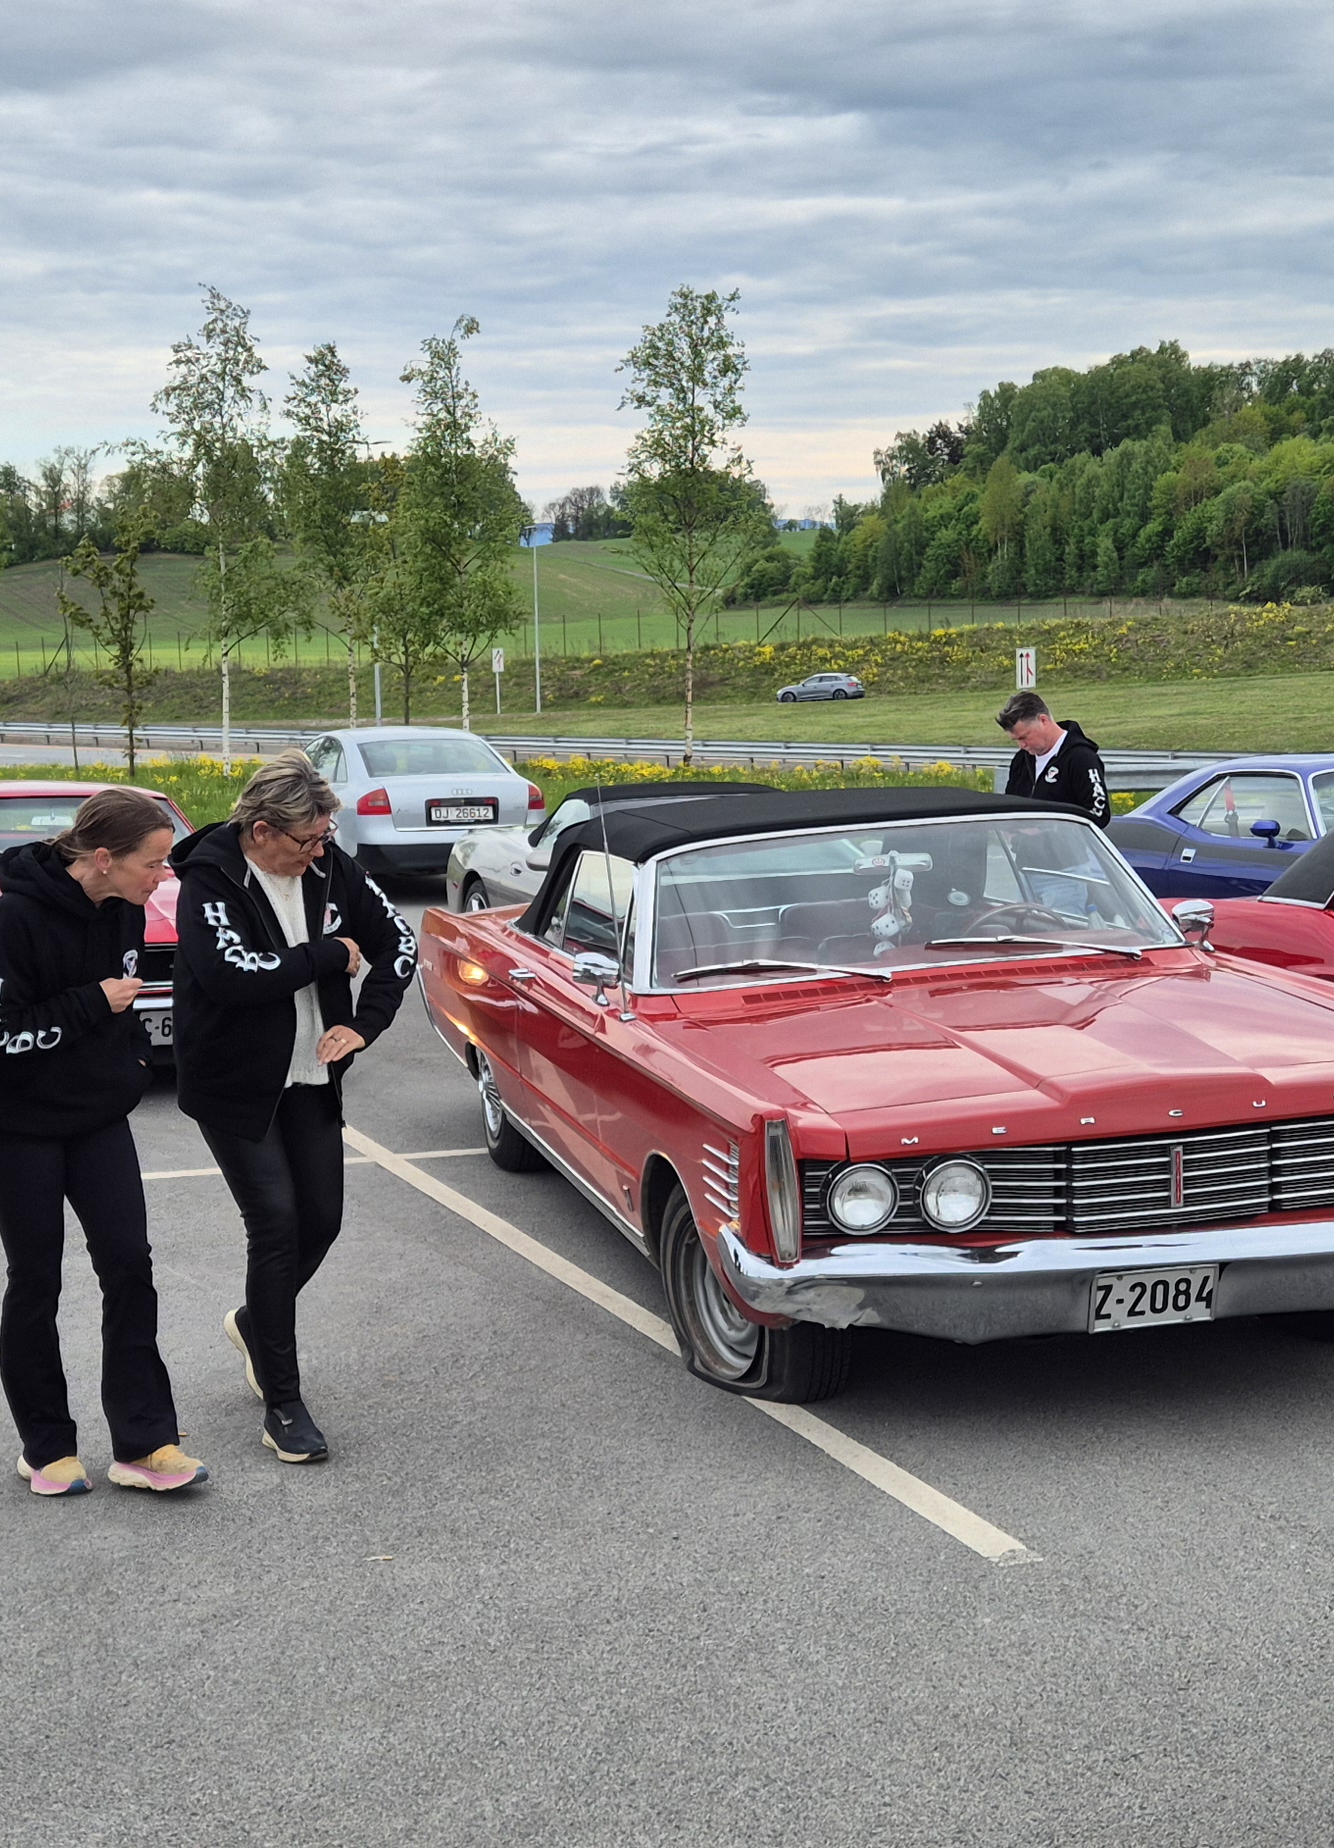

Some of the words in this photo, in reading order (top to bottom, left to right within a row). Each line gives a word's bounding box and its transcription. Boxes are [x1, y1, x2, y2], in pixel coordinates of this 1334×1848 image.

[434, 808, 451, 819] DJ
[455, 807, 490, 818] 26612
[1094, 1274, 1214, 1321] Z-2084
